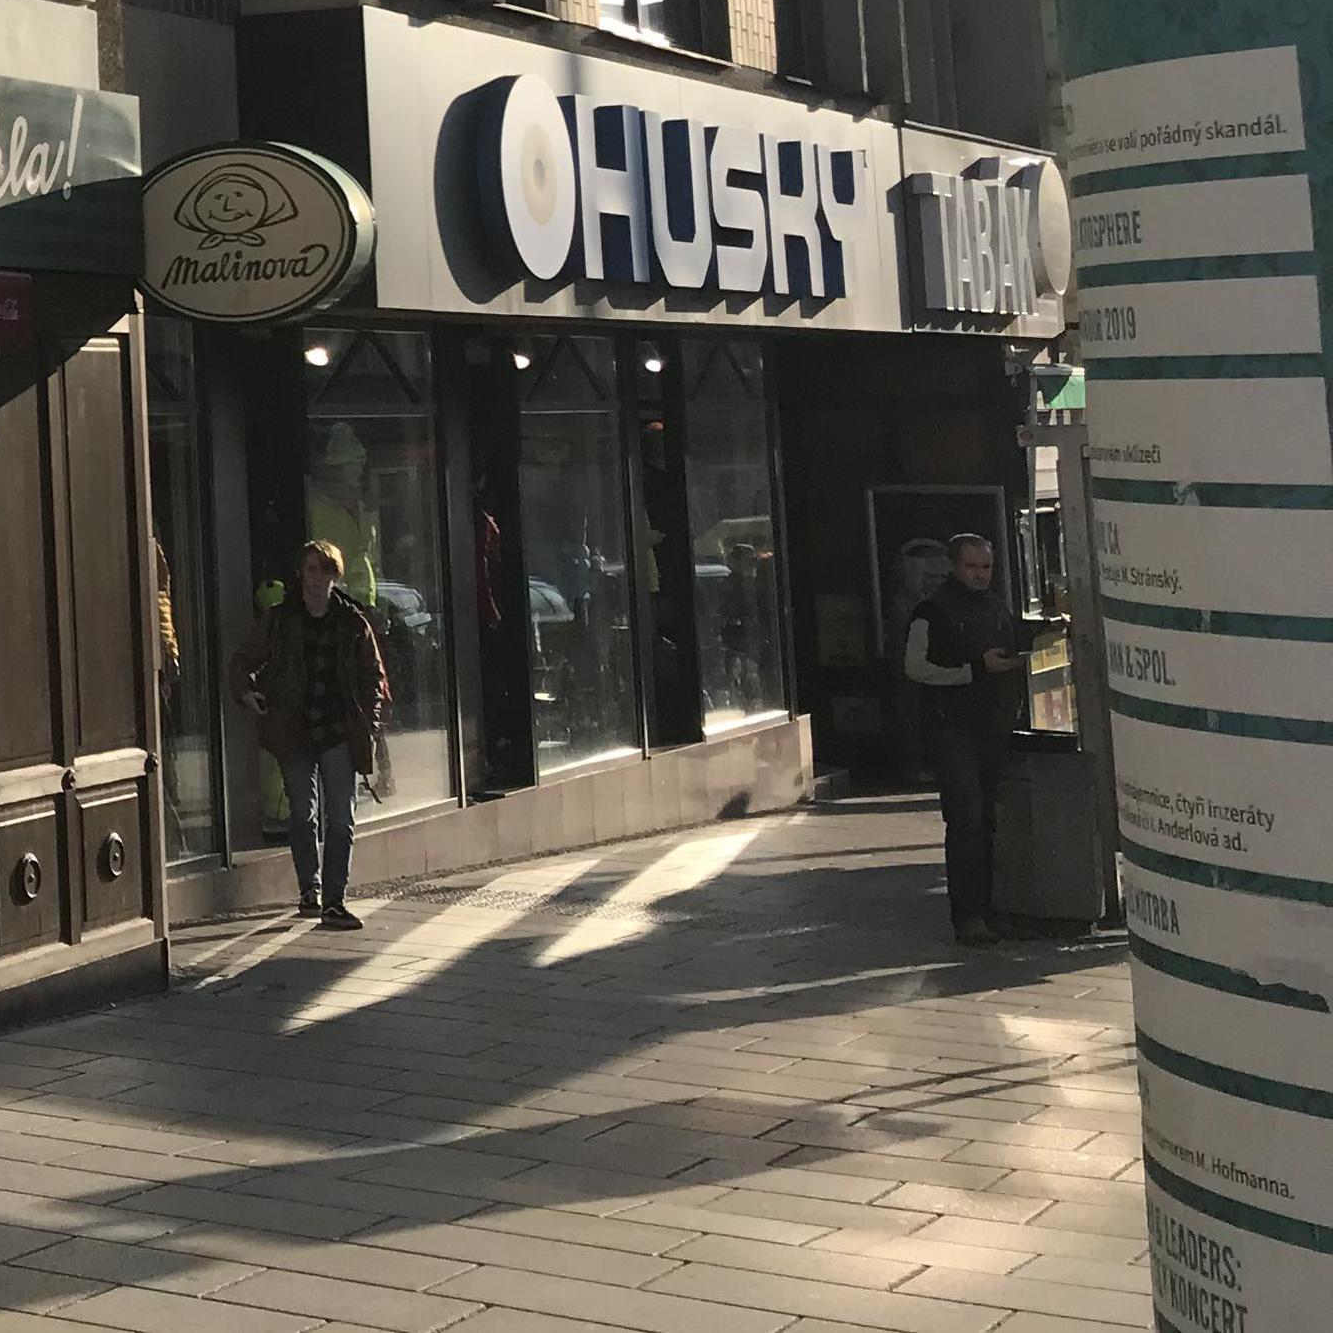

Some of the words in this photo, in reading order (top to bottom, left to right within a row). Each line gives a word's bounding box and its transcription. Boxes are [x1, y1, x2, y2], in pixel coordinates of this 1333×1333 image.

[1140, 120, 1201, 151] pořádný
[1205, 114, 1288, 142] skandál.
[571, 93, 867, 301] HUSKY
[1104, 306, 1137, 342] 2019
[1131, 566, 1182, 595] Stránský.
[1208, 799, 1276, 834] inzeráty
[1158, 817, 1219, 847] Anderlová
[1222, 831, 1248, 854] ad.
[1211, 1155, 1296, 1201] Hofmanna.
[1163, 1213, 1243, 1293] LEADERS:
